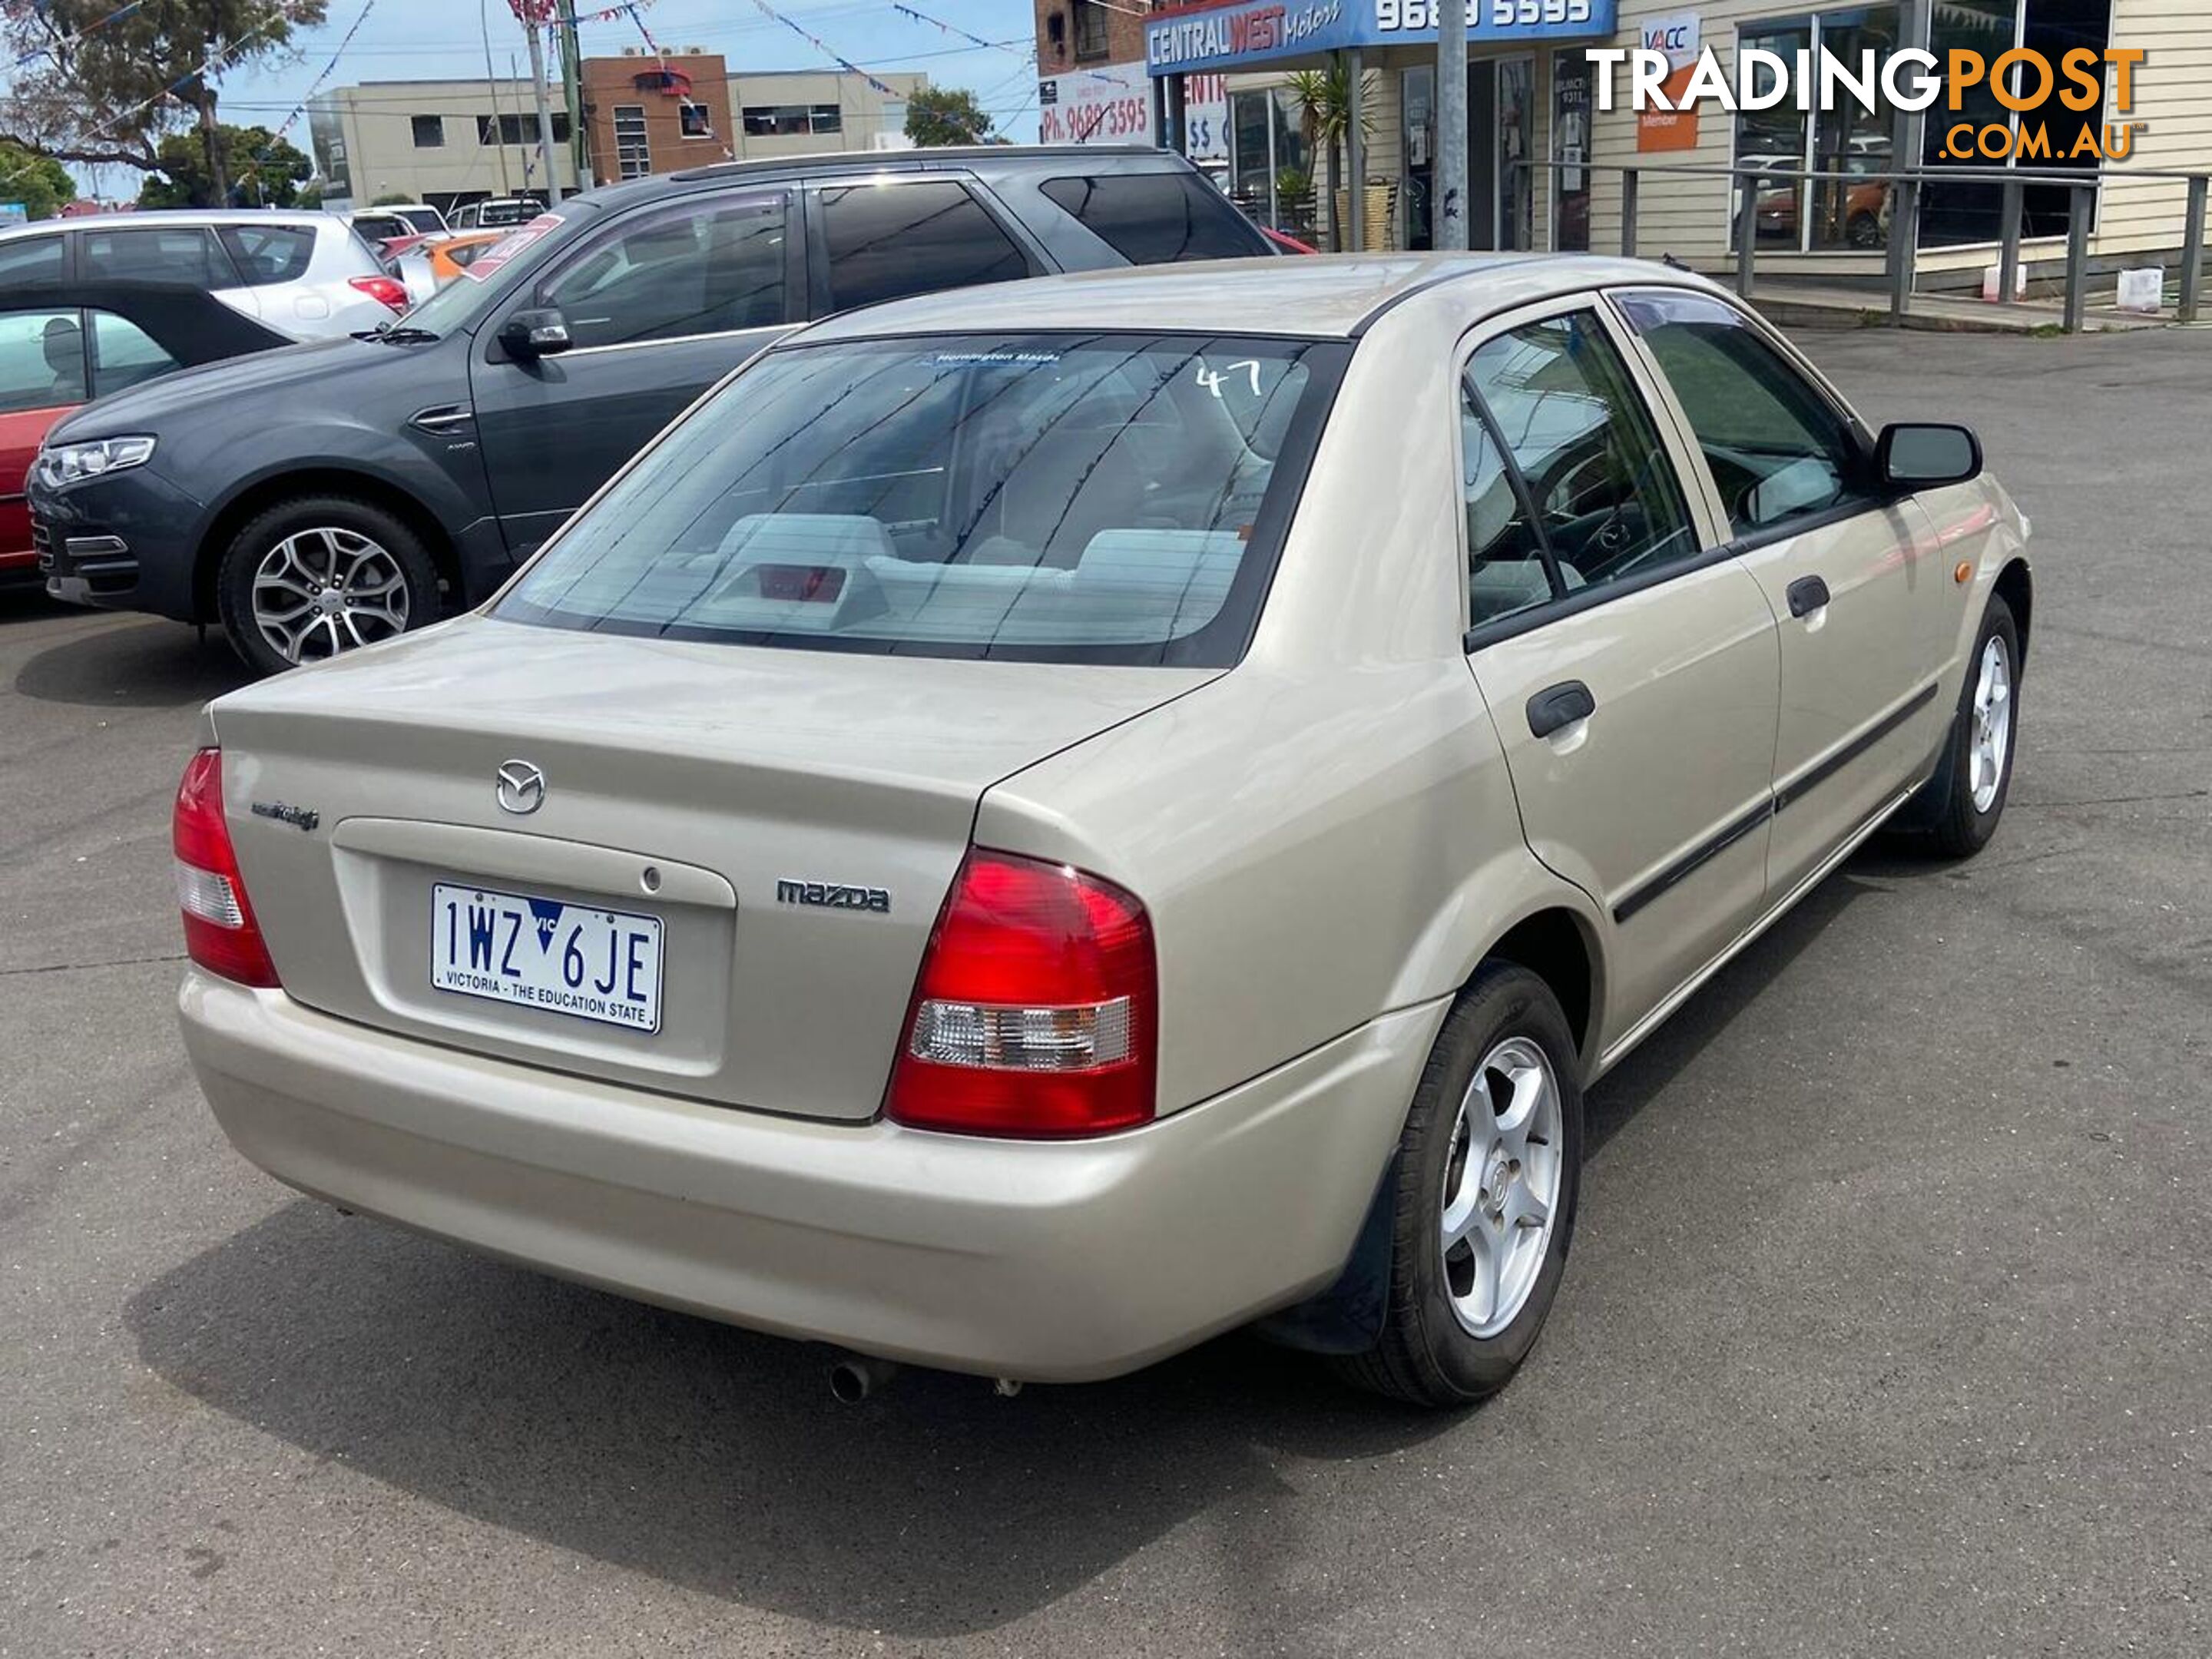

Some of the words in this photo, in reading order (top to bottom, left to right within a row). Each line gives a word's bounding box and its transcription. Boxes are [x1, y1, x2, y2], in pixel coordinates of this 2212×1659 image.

[1150, 15, 1230, 65] CENTRAL
[1229, 5, 1287, 55] WEST
[1043, 108, 1065, 141] Ph.
[1068, 103, 1103, 140] 9689
[1109, 98, 1147, 136] 5595
[446, 971, 500, 993] VICTORIA
[512, 983, 535, 999] THE
[538, 988, 606, 1015] EDUCATION
[609, 1002, 645, 1023] STATE
